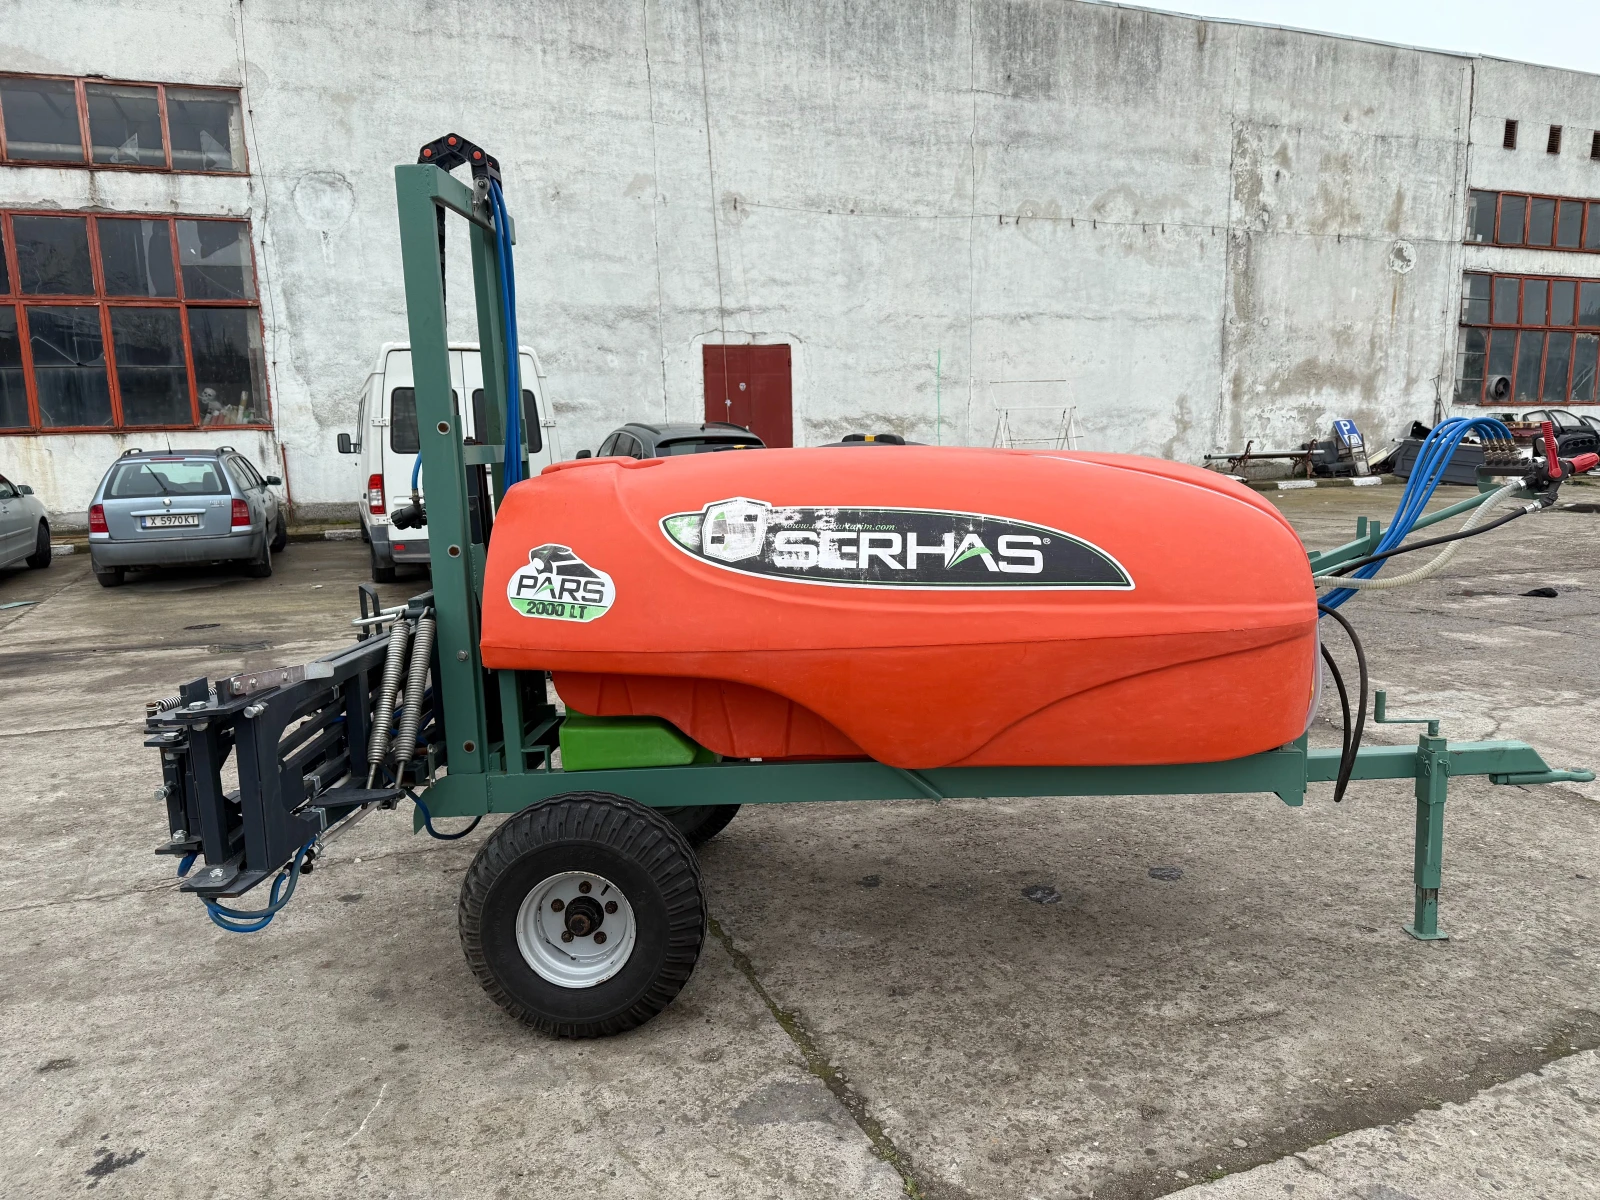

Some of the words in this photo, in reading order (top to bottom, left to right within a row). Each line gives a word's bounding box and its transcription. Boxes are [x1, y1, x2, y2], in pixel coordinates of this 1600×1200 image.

[1340, 421, 1350, 435] P
[516, 574, 606, 604] PARS
[526, 601, 566, 616] 2000
[569, 604, 588, 619] LT
